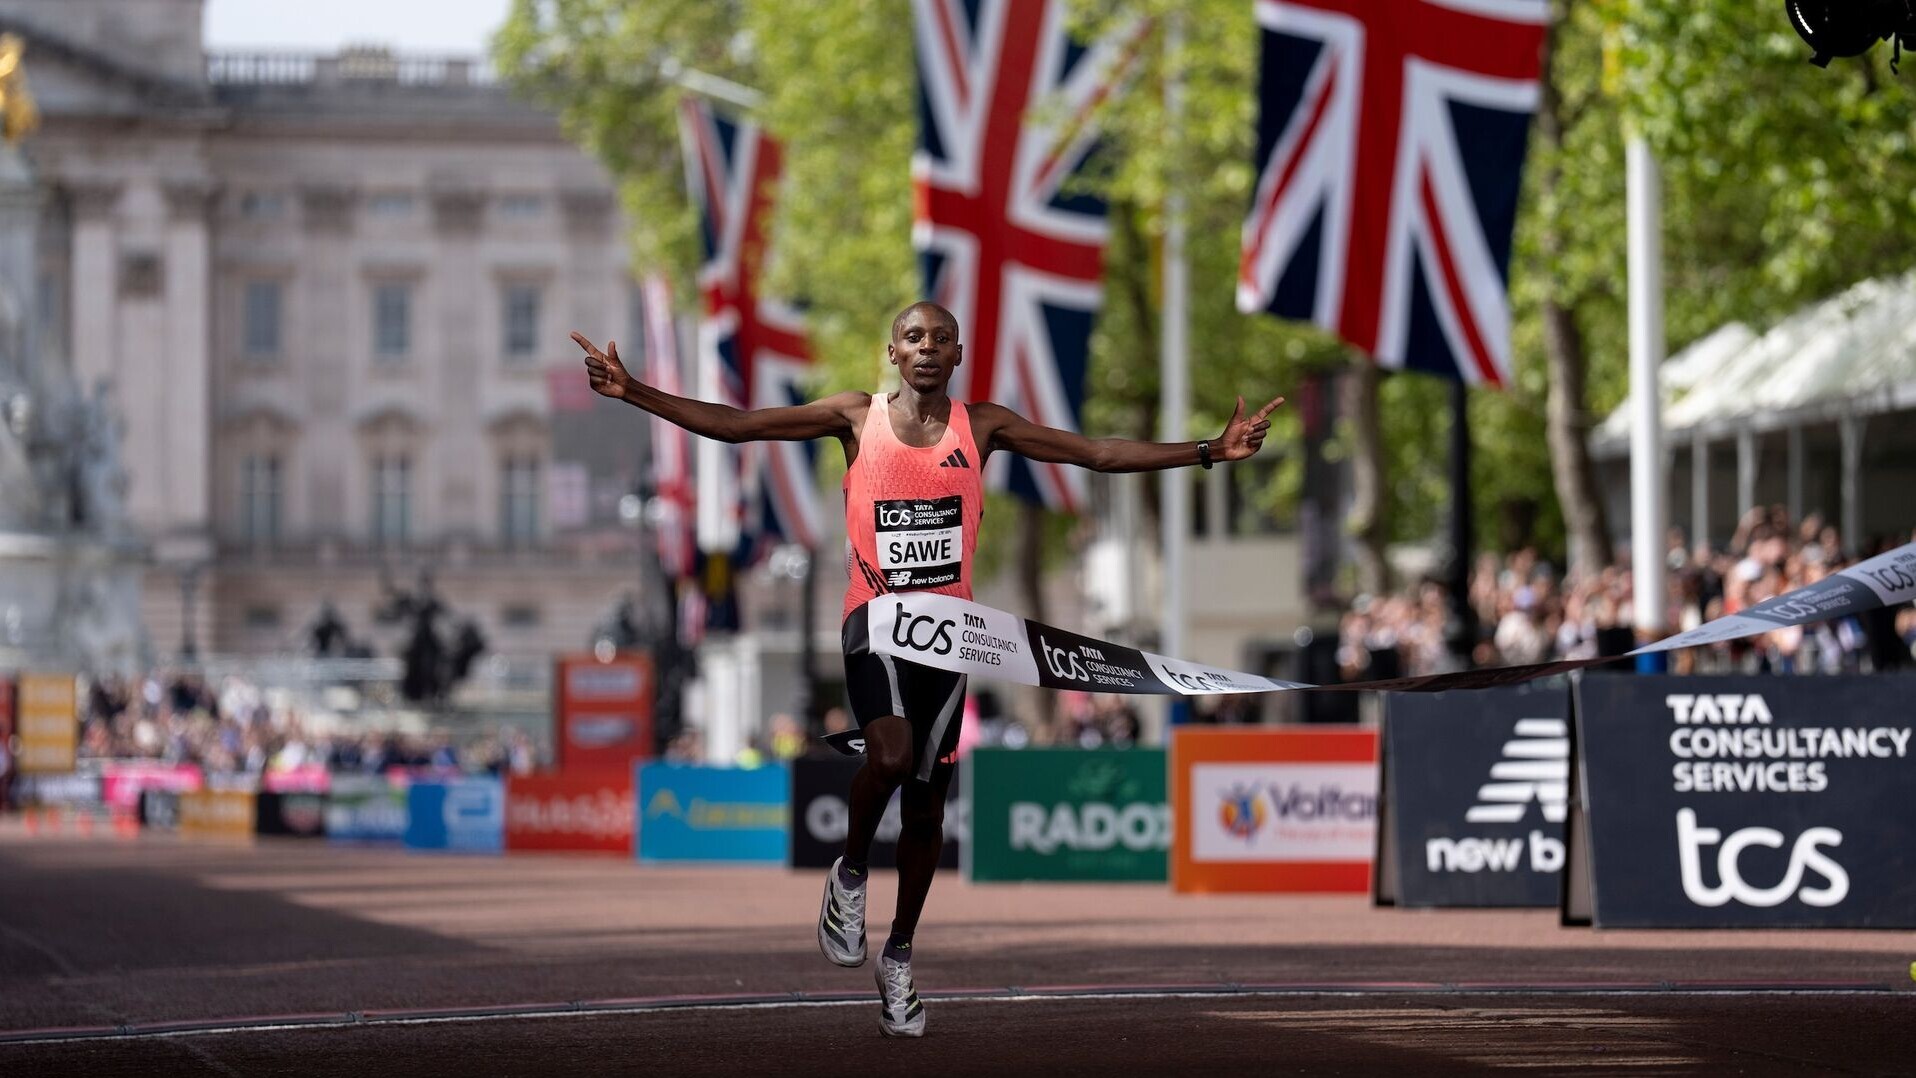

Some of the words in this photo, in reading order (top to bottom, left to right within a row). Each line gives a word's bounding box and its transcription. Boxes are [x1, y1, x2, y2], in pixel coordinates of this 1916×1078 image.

[880, 506, 911, 526] tcs
[914, 508, 958, 519] CONSULTANCY
[914, 517, 944, 525] SERVICES
[889, 539, 952, 564] SAWE
[912, 577, 927, 585] new
[928, 573, 954, 584] balance
[1860, 564, 1914, 592] tcs
[1755, 600, 1818, 620] tcs
[892, 601, 956, 655] tcs
[963, 612, 987, 630] TATA
[962, 630, 1018, 653] CONSULTANCY
[959, 647, 1001, 666] SERVICES
[1040, 634, 1090, 682] tcs
[1079, 645, 1106, 661] TATA
[1085, 660, 1144, 680] CONSULTANCY
[1203, 671, 1232, 683] TATA
[1093, 673, 1135, 688] SERVICES
[1665, 693, 1774, 724] TATA
[1668, 726, 1913, 759] CONSULTANCY
[1672, 761, 1829, 792] SERVICES
[1425, 837, 1524, 873] new
[1675, 807, 1851, 908] tcs
